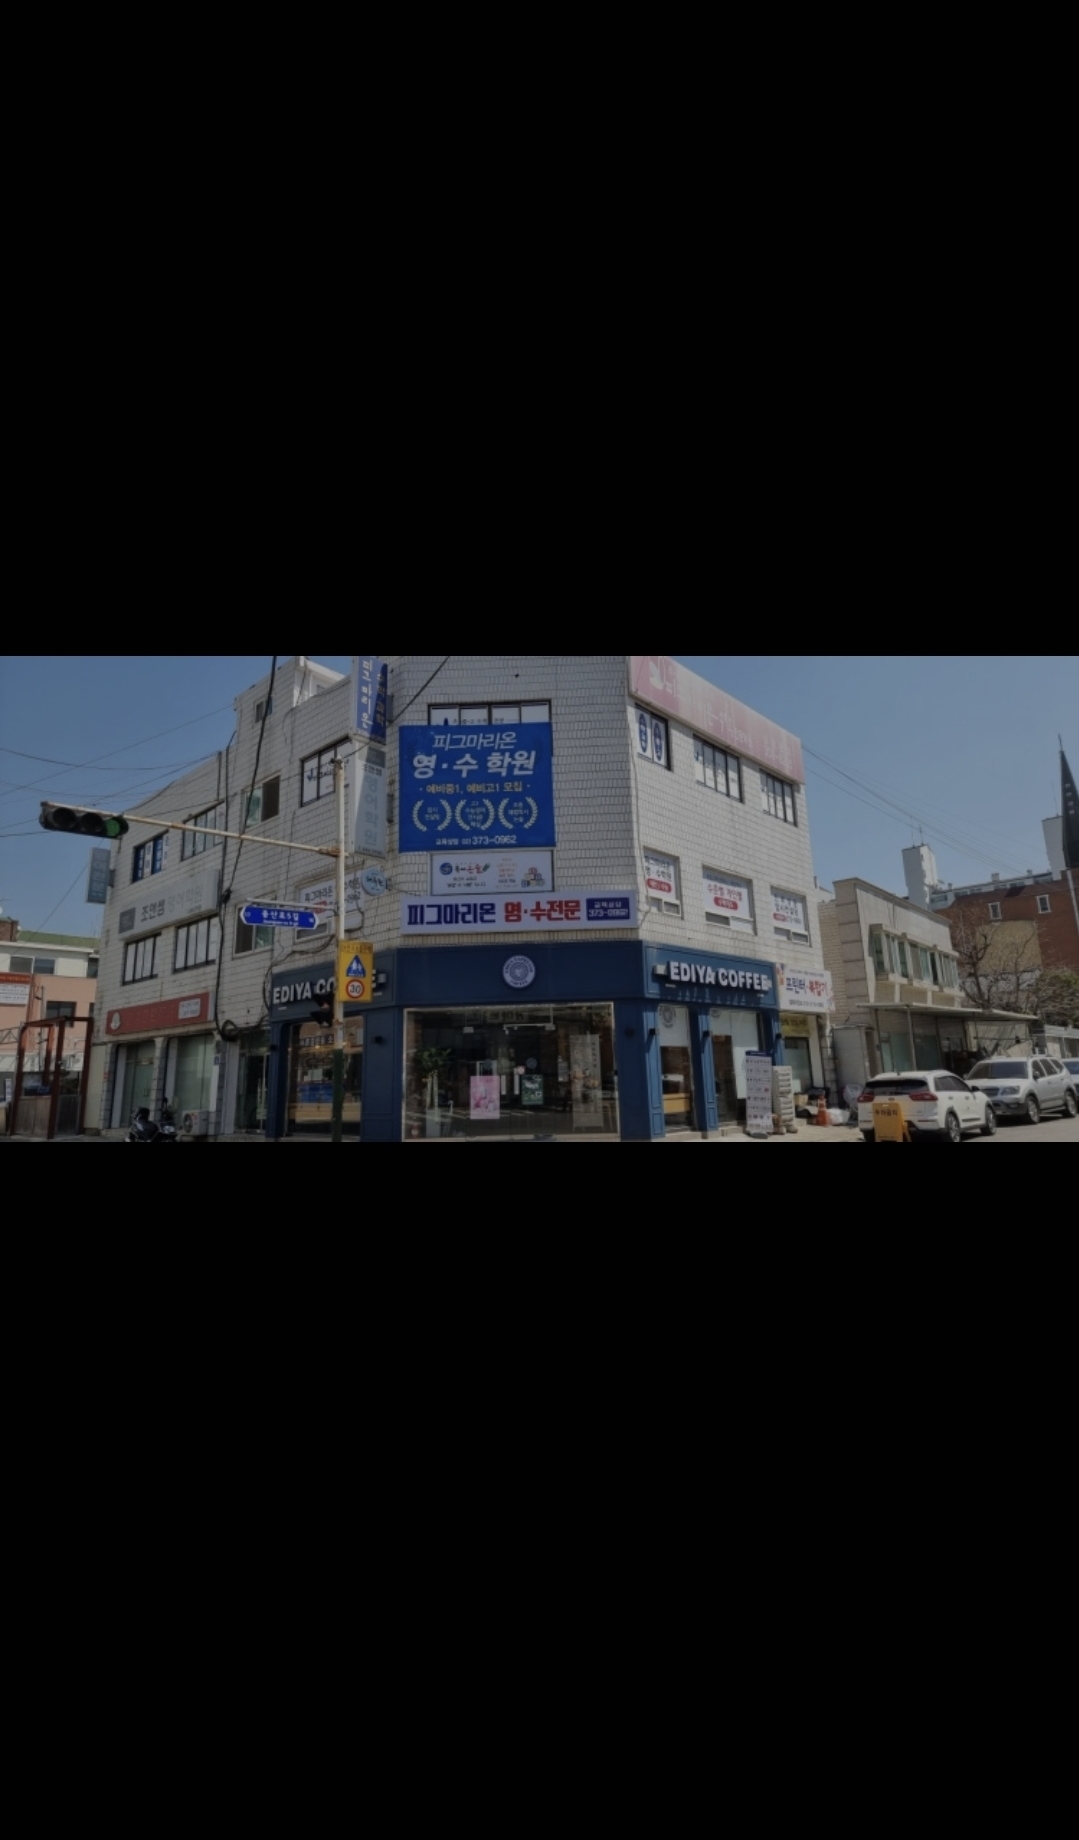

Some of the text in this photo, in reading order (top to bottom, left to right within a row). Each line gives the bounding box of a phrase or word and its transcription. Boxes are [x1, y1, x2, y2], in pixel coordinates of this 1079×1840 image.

[360, 658, 374, 729] 피그마리온
[432, 731, 517, 751] 피그마리온
[412, 753, 479, 779] 영·수
[487, 751, 536, 777] 학원
[503, 781, 523, 792] 모집
[304, 885, 333, 903] 피그마리온
[407, 898, 581, 926] 피그마리온 영·수전문
[669, 961, 769, 991] EDIYA COFFEE
[273, 981, 312, 1004] EDIYA
[349, 984, 361, 995] 30
